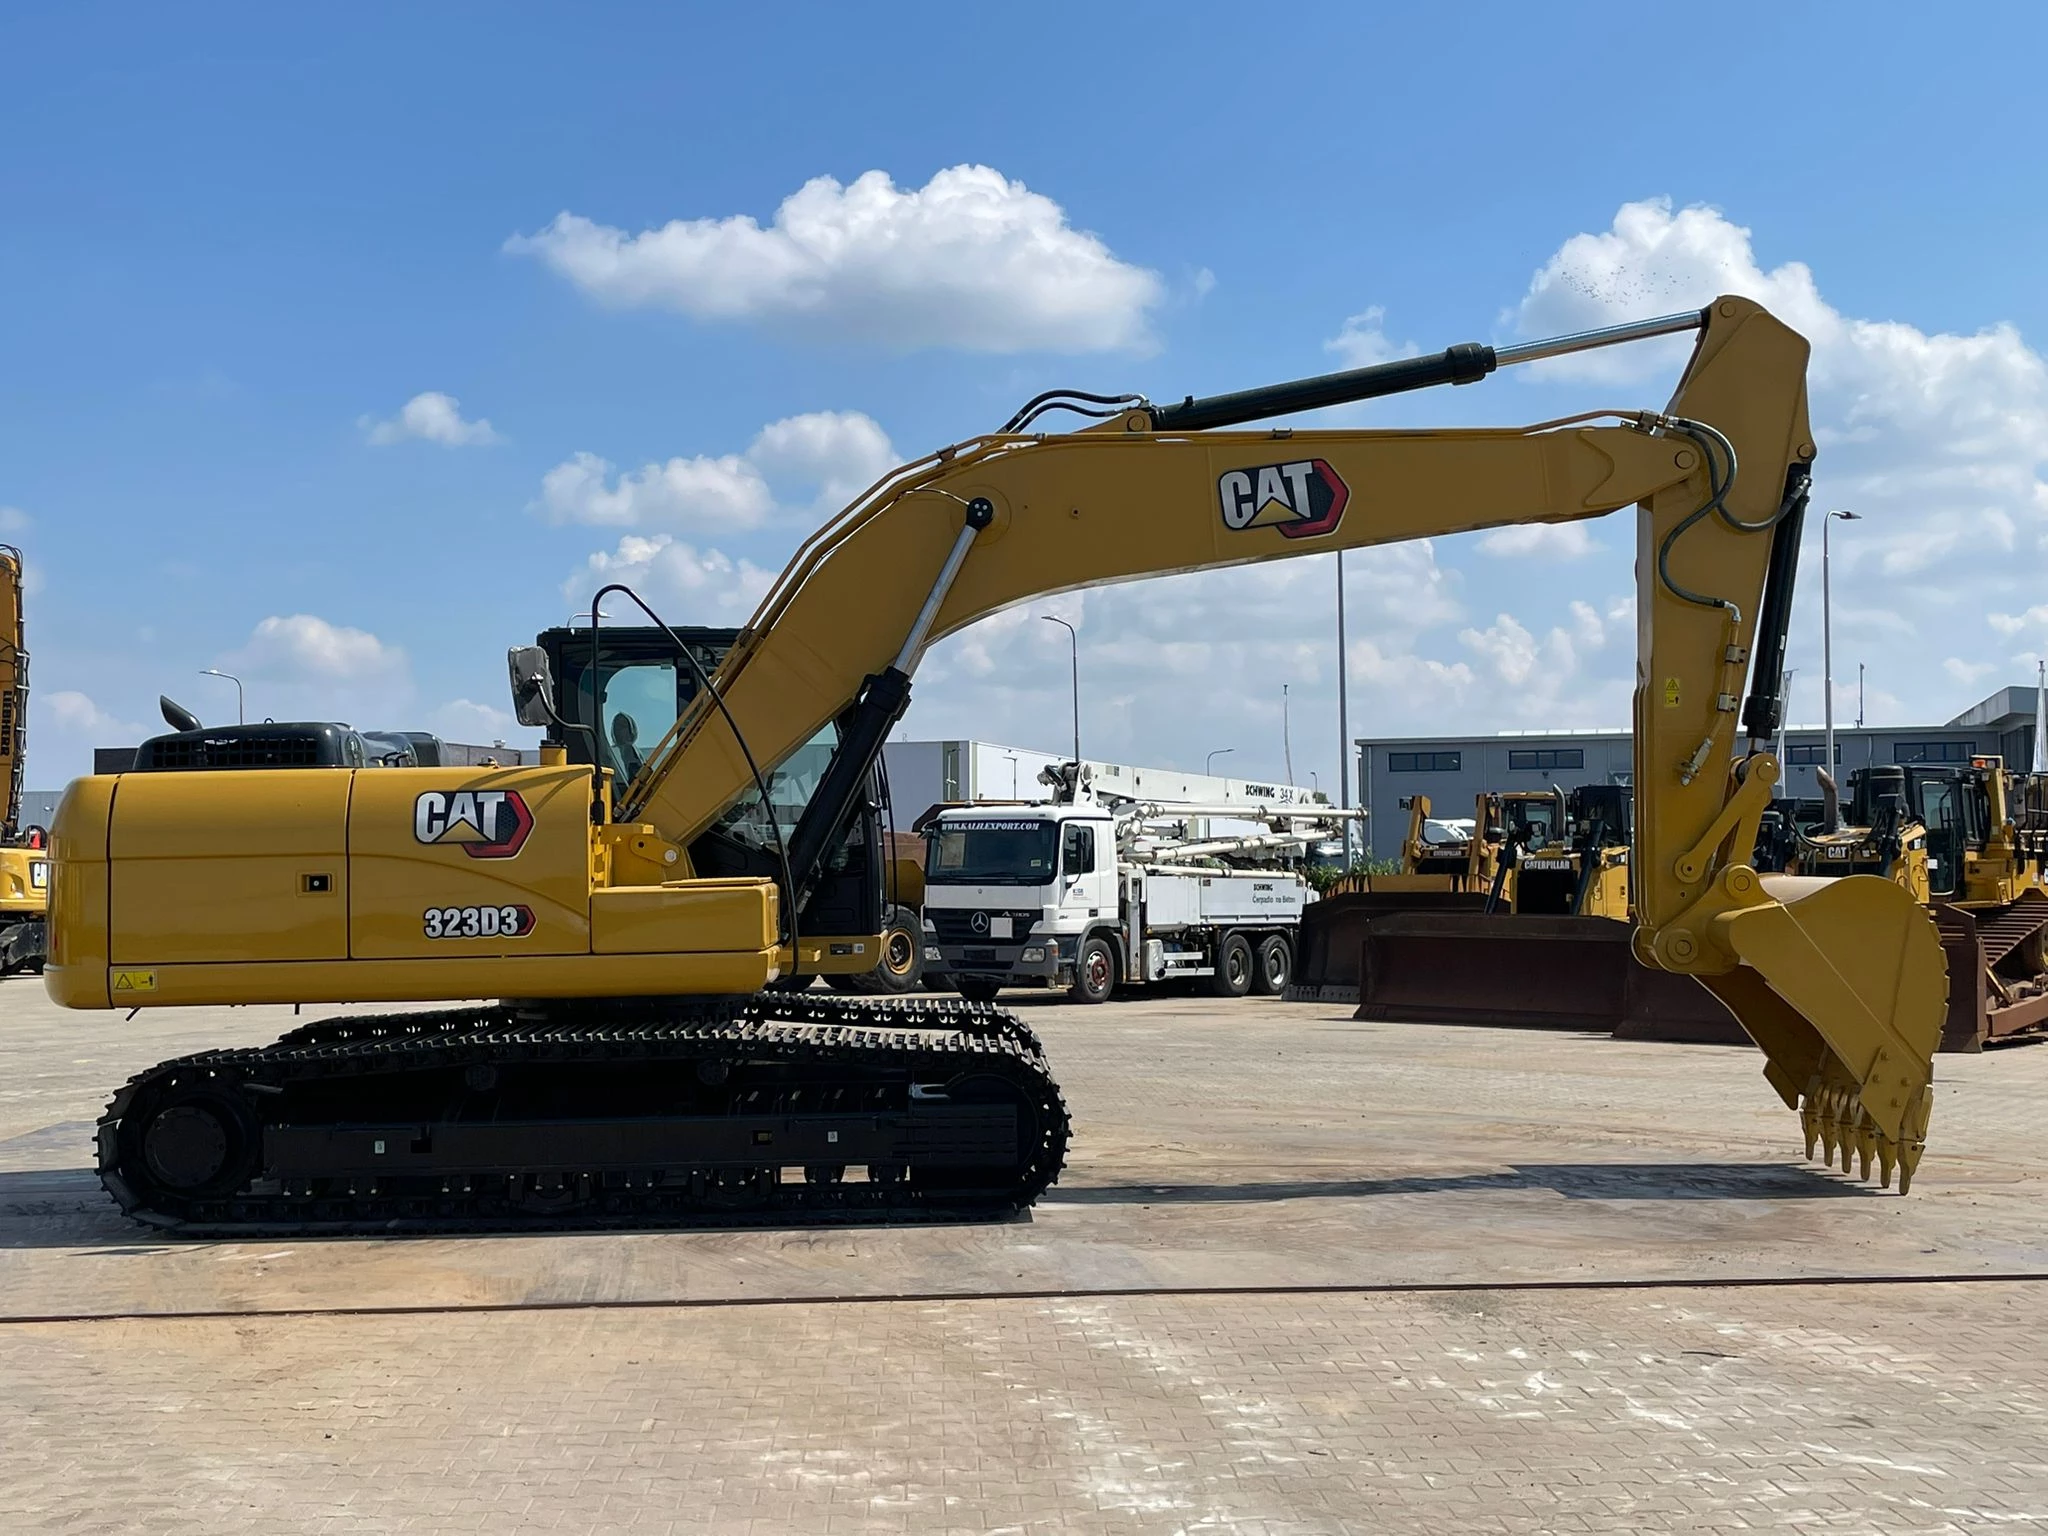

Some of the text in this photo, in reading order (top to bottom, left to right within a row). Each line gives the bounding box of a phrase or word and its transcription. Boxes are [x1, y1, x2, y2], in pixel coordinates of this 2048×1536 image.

[1220, 461, 1313, 529] CAT
[1, 690, 13, 756] LIEBHERR
[1245, 784, 1275, 798] SCHWING
[416, 791, 506, 843] CAT
[941, 822, 1040, 831] WWW.KALILEXPORT.COM
[1827, 845, 1847, 859] CAT
[1524, 860, 1571, 870] CATERPILLAR
[424, 906, 518, 937] 323D3
